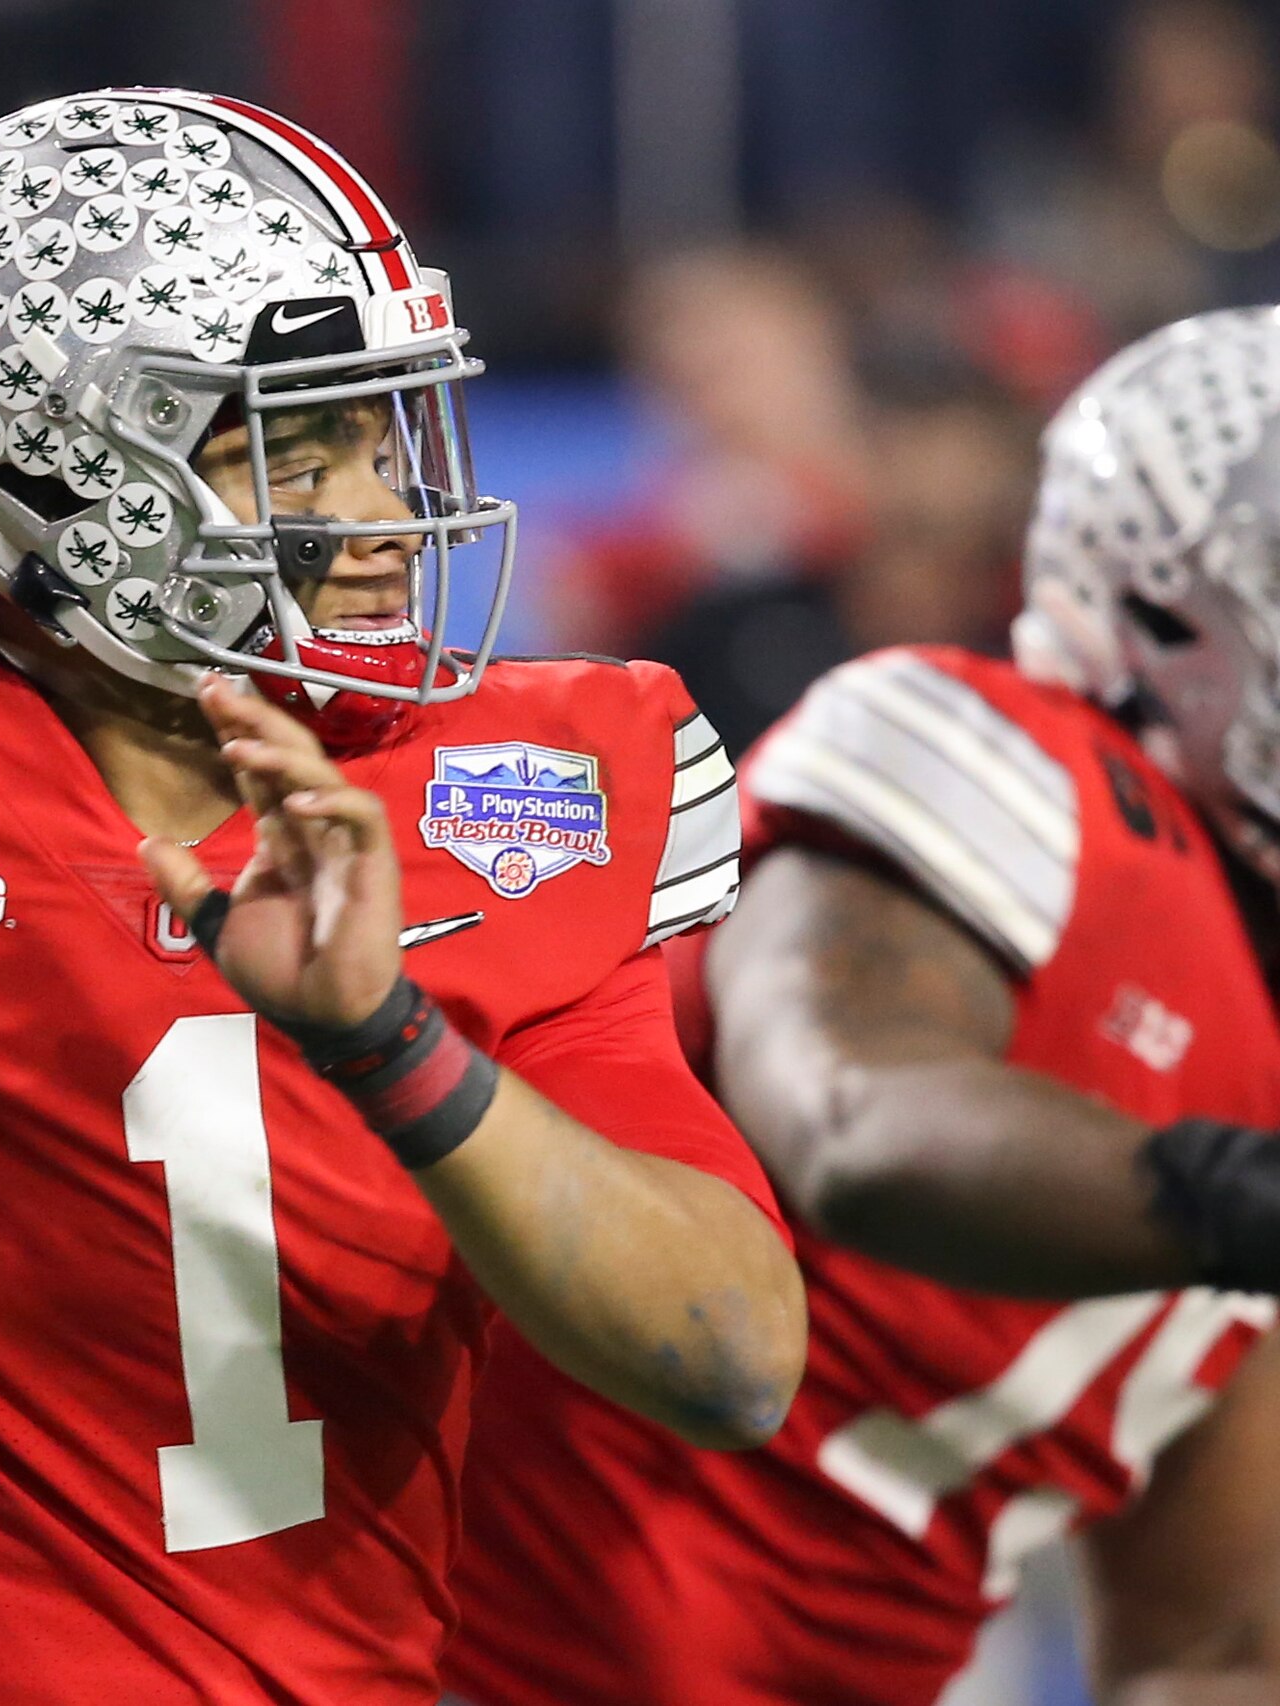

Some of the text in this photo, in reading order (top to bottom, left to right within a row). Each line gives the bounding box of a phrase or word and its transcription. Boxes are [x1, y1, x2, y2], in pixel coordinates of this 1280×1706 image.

[482, 793, 595, 821] PlayStation
[429, 816, 601, 854] Fiesta Bowl
[122, 1012, 325, 1553] 1
